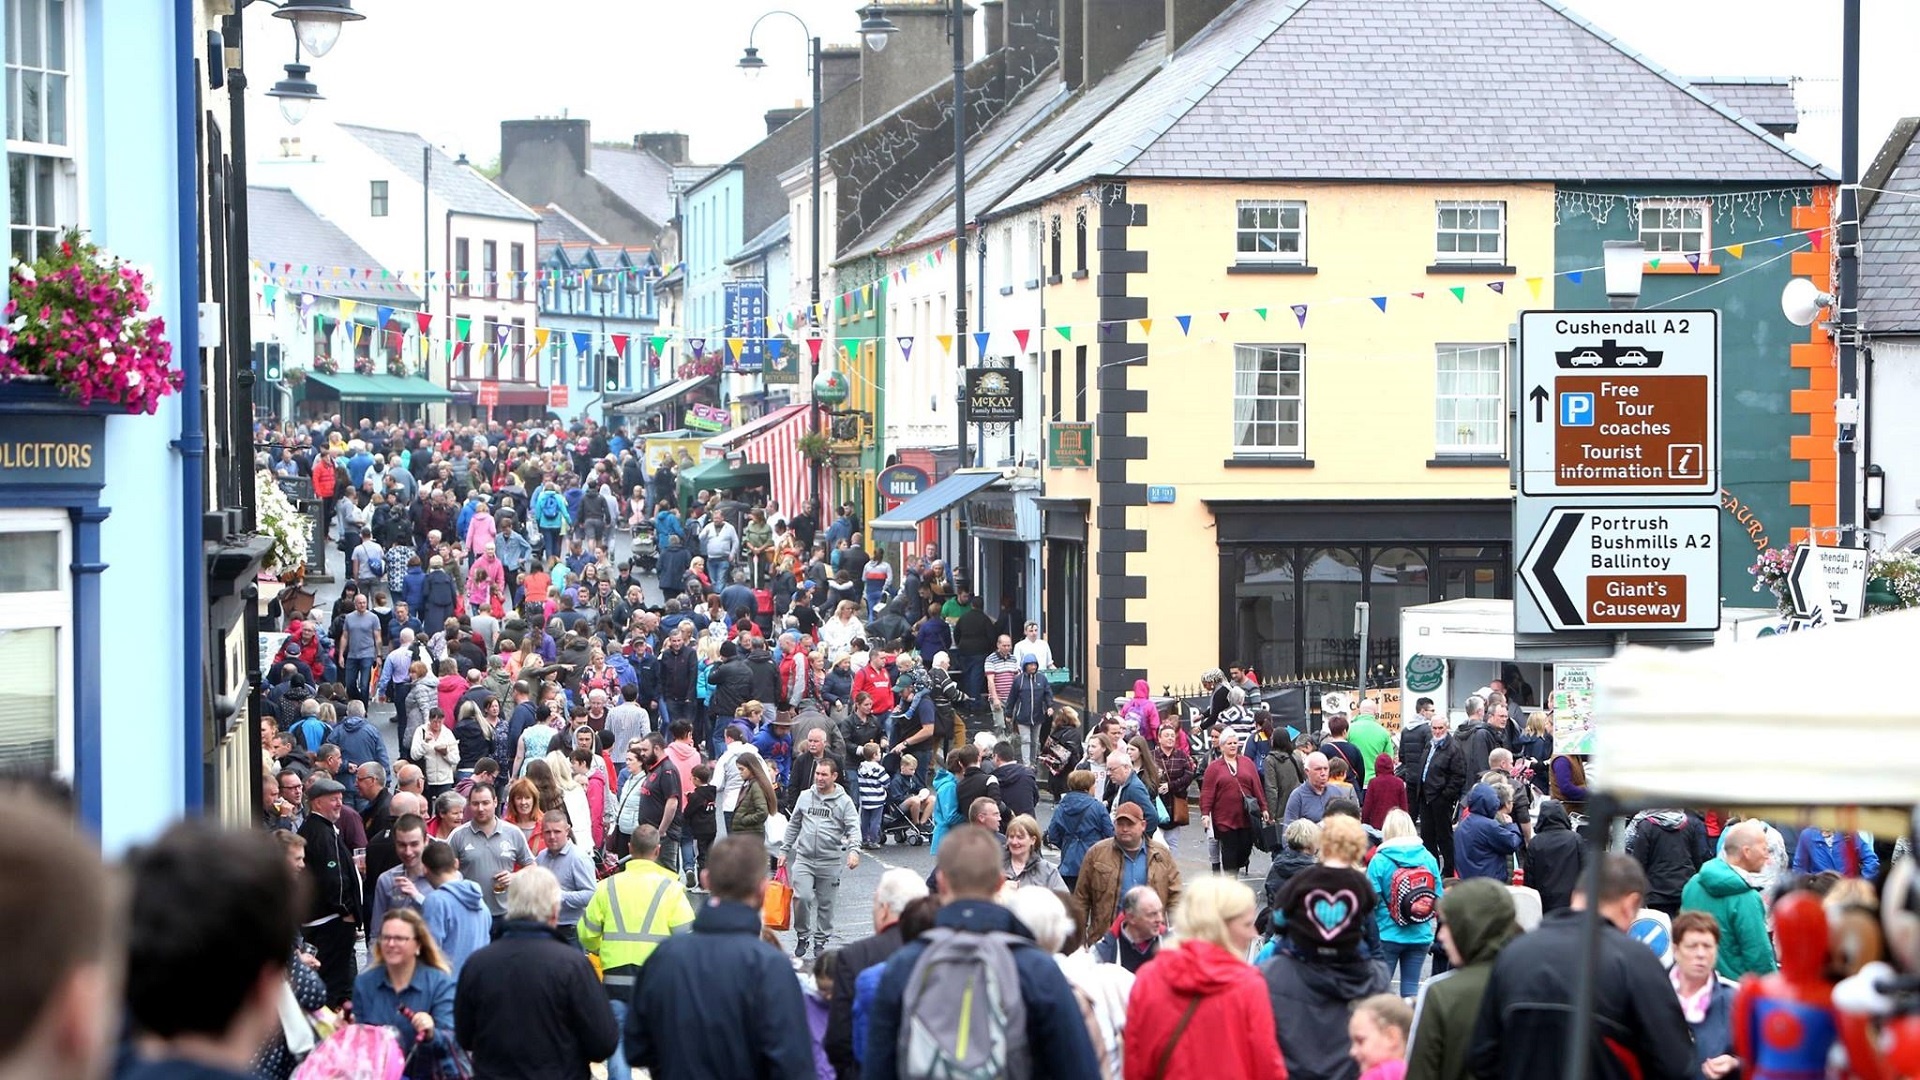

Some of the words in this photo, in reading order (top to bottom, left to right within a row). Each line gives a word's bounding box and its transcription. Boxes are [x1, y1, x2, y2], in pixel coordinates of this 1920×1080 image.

[1555, 319, 1657, 335] Cushendall
[1663, 319, 1690, 334] A2
[1601, 381, 1639, 397] Free
[1615, 401, 1655, 416] Tour
[1599, 420, 1671, 435] coaches
[0, 442, 92, 468] LICITORS
[1580, 444, 1642, 459] Tourist
[1560, 464, 1663, 479] information
[890, 481, 918, 494] HILL
[1591, 516, 1668, 530] Portrush
[1591, 535, 1678, 549] Bushmills
[1685, 534, 1711, 549] A2
[1591, 554, 1671, 571] Ballintoy
[1606, 581, 1667, 597] Giant's
[1592, 601, 1681, 619] Causeway
[808, 807, 830, 818] PUMA
